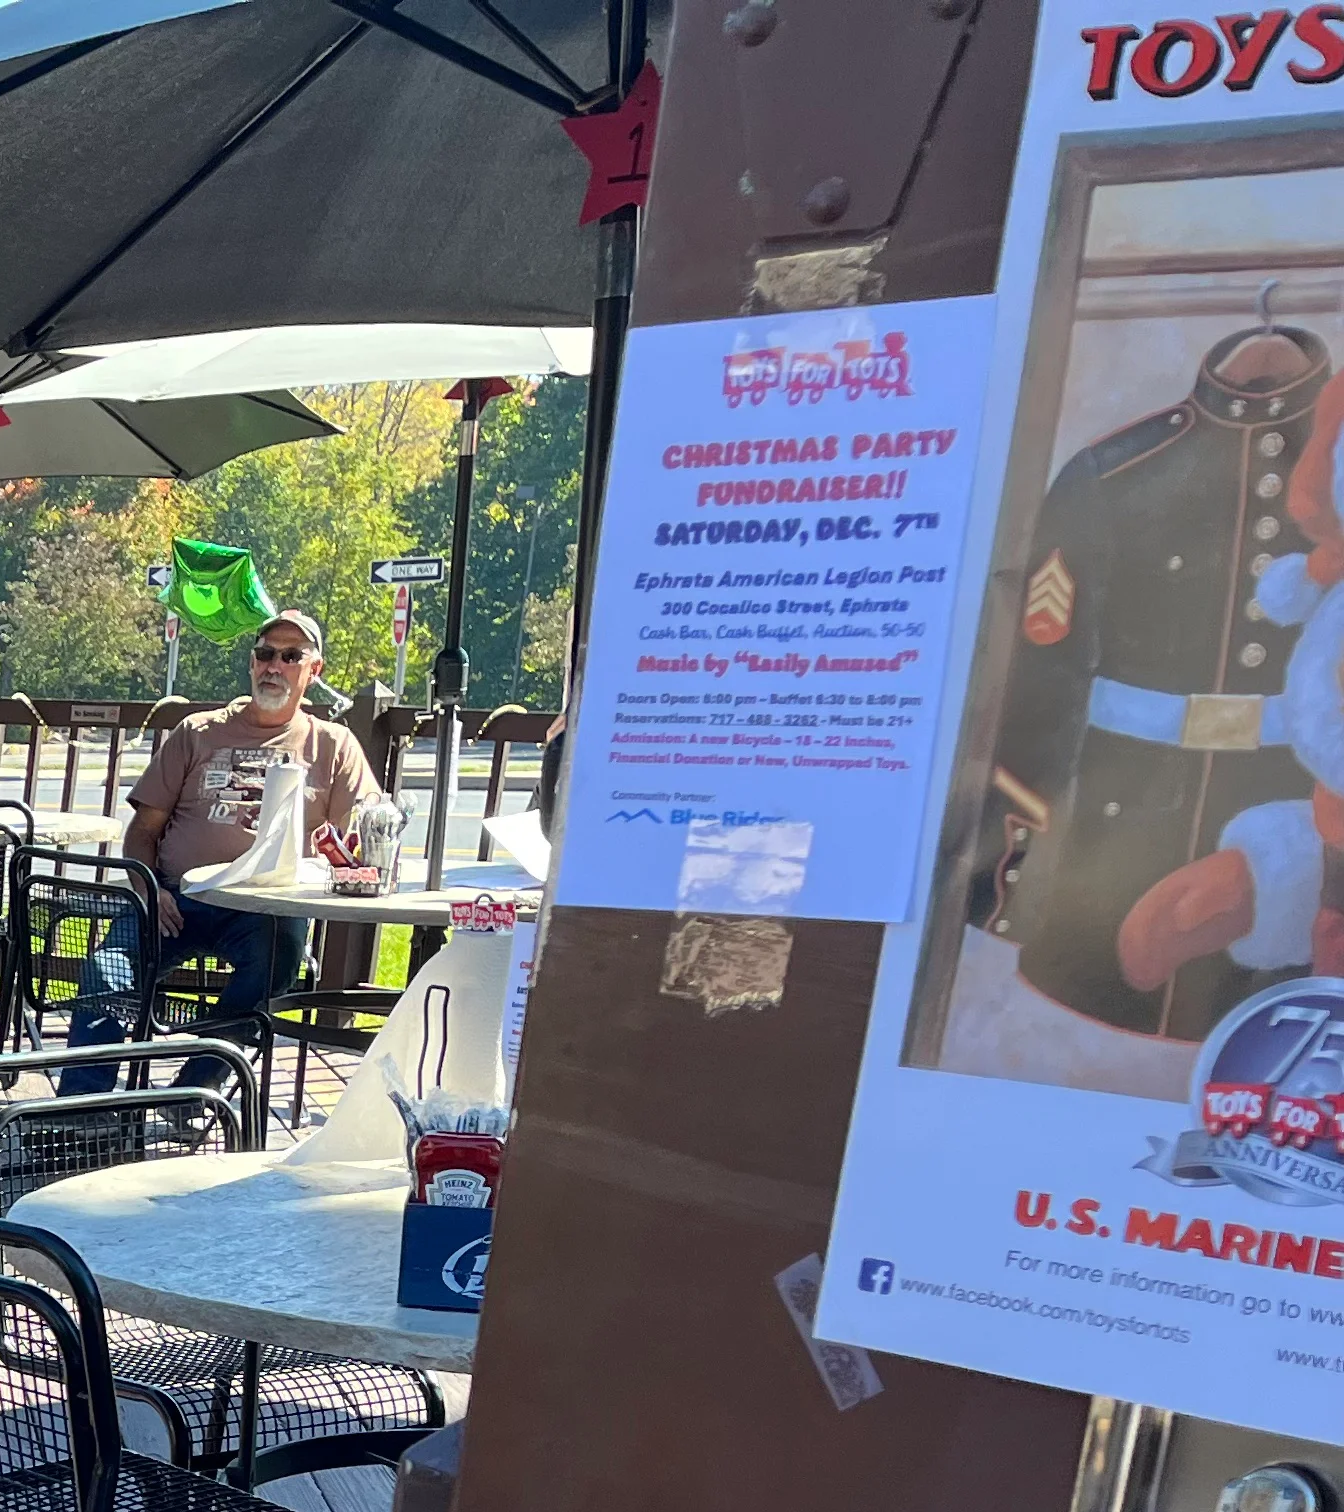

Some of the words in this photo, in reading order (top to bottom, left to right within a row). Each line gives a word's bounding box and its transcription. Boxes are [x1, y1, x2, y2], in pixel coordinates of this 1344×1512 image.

[1081, 5, 1344, 101] TOYS
[607, 121, 650, 185] 1
[791, 363, 832, 387] FOR
[662, 435, 839, 470] CHRISTMAS
[850, 428, 957, 460] PARTY
[697, 469, 909, 507] FUNDRAISER!!
[654, 518, 809, 548] SATURDAY,
[815, 516, 882, 541] DEC.
[893, 512, 940, 540] 7TH
[392, 565, 412, 576] ONE
[416, 564, 435, 575] WAY
[634, 572, 714, 592] Ephrata
[716, 568, 819, 588] American
[823, 566, 893, 589] Legion
[897, 565, 947, 584] Post
[661, 601, 693, 616] 300
[696, 599, 771, 615] Cocalico
[776, 599, 835, 616] Street,
[840, 598, 910, 616] Ephrata
[639, 625, 677, 640] Cash
[716, 624, 754, 640] Cash
[637, 653, 699, 672] Music
[703, 652, 729, 678] by
[617, 692, 657, 705] Doors
[734, 695, 757, 707] pm
[769, 693, 812, 705] Buffet
[848, 694, 862, 705] to
[898, 696, 923, 709] pm
[709, 713, 735, 725] 717
[828, 714, 864, 726] Must
[867, 715, 884, 727] be
[688, 733, 698, 744] A
[700, 736, 729, 744] new
[732, 733, 782, 747] Bicycle
[823, 735, 841, 746] 22
[609, 751, 671, 763] Financial
[673, 753, 735, 765] Donation
[737, 757, 754, 766] or
[792, 755, 873, 770] Unwrapped
[1207, 1089, 1263, 1119] TOYS
[1274, 1101, 1320, 1132] FOR
[441, 1193, 475, 1201] TOMATO
[444, 1179, 474, 1189] HEINZ
[1122, 1207, 1344, 1280] MARINE
[1004, 1249, 1043, 1271] For
[1046, 1261, 1104, 1284] more
[1109, 1266, 1236, 1308] information
[1240, 1295, 1273, 1317] go
[1280, 1299, 1302, 1320] to
[900, 1276, 1192, 1345] www.facebook.com/toysfortots
